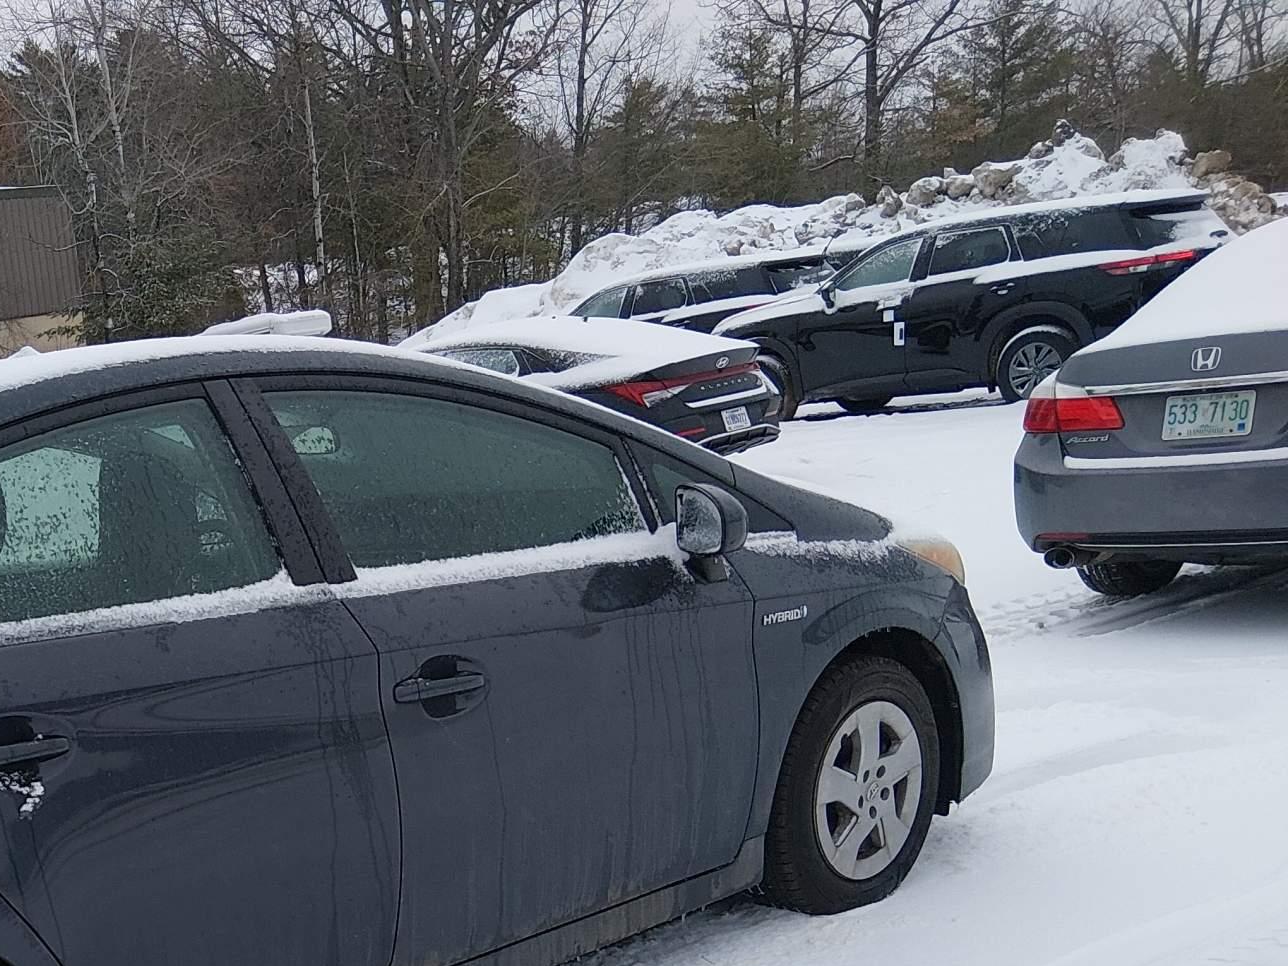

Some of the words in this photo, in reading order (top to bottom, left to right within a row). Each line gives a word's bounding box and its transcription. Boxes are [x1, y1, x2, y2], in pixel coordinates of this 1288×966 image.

[1167, 403, 1199, 425] 533
[1208, 399, 1250, 423] 7130
[1066, 433, 1110, 444] Accord
[763, 607, 802, 627] HYBRID
